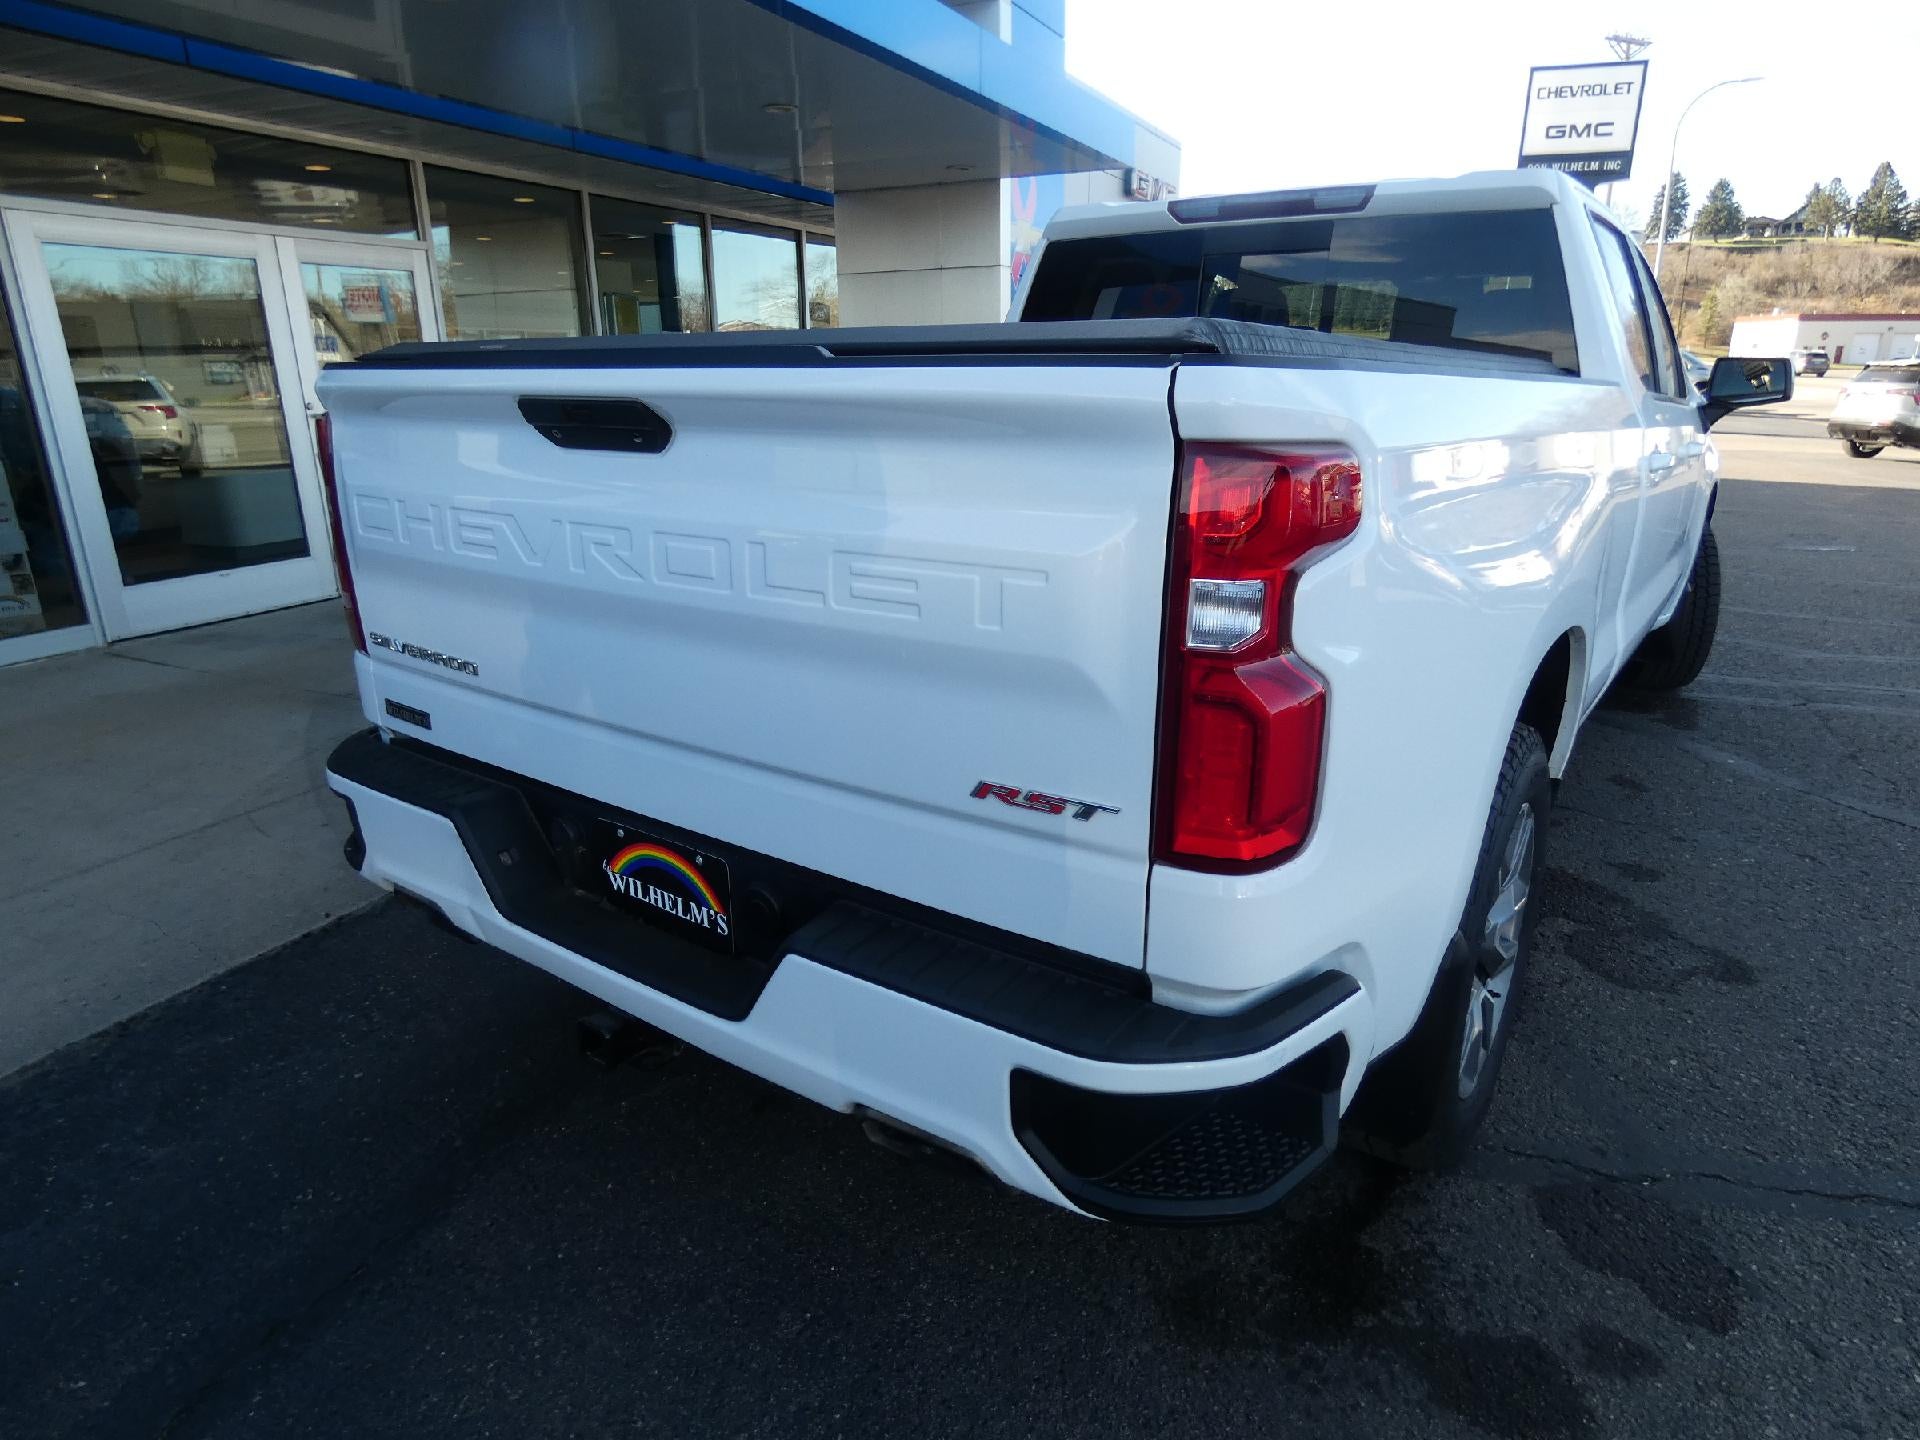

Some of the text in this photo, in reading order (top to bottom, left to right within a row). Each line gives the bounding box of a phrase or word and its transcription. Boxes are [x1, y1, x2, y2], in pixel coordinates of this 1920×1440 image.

[1537, 82, 1634, 100] CHEVROLET
[1545, 122, 1614, 139] GMC
[1552, 161, 1599, 171] WILHELM
[1603, 160, 1622, 171] INC
[352, 494, 1049, 630] CHEVROLET
[369, 631, 480, 676] SILVERADO
[970, 780, 1121, 822] RST
[607, 870, 729, 936] WILHELM'S
